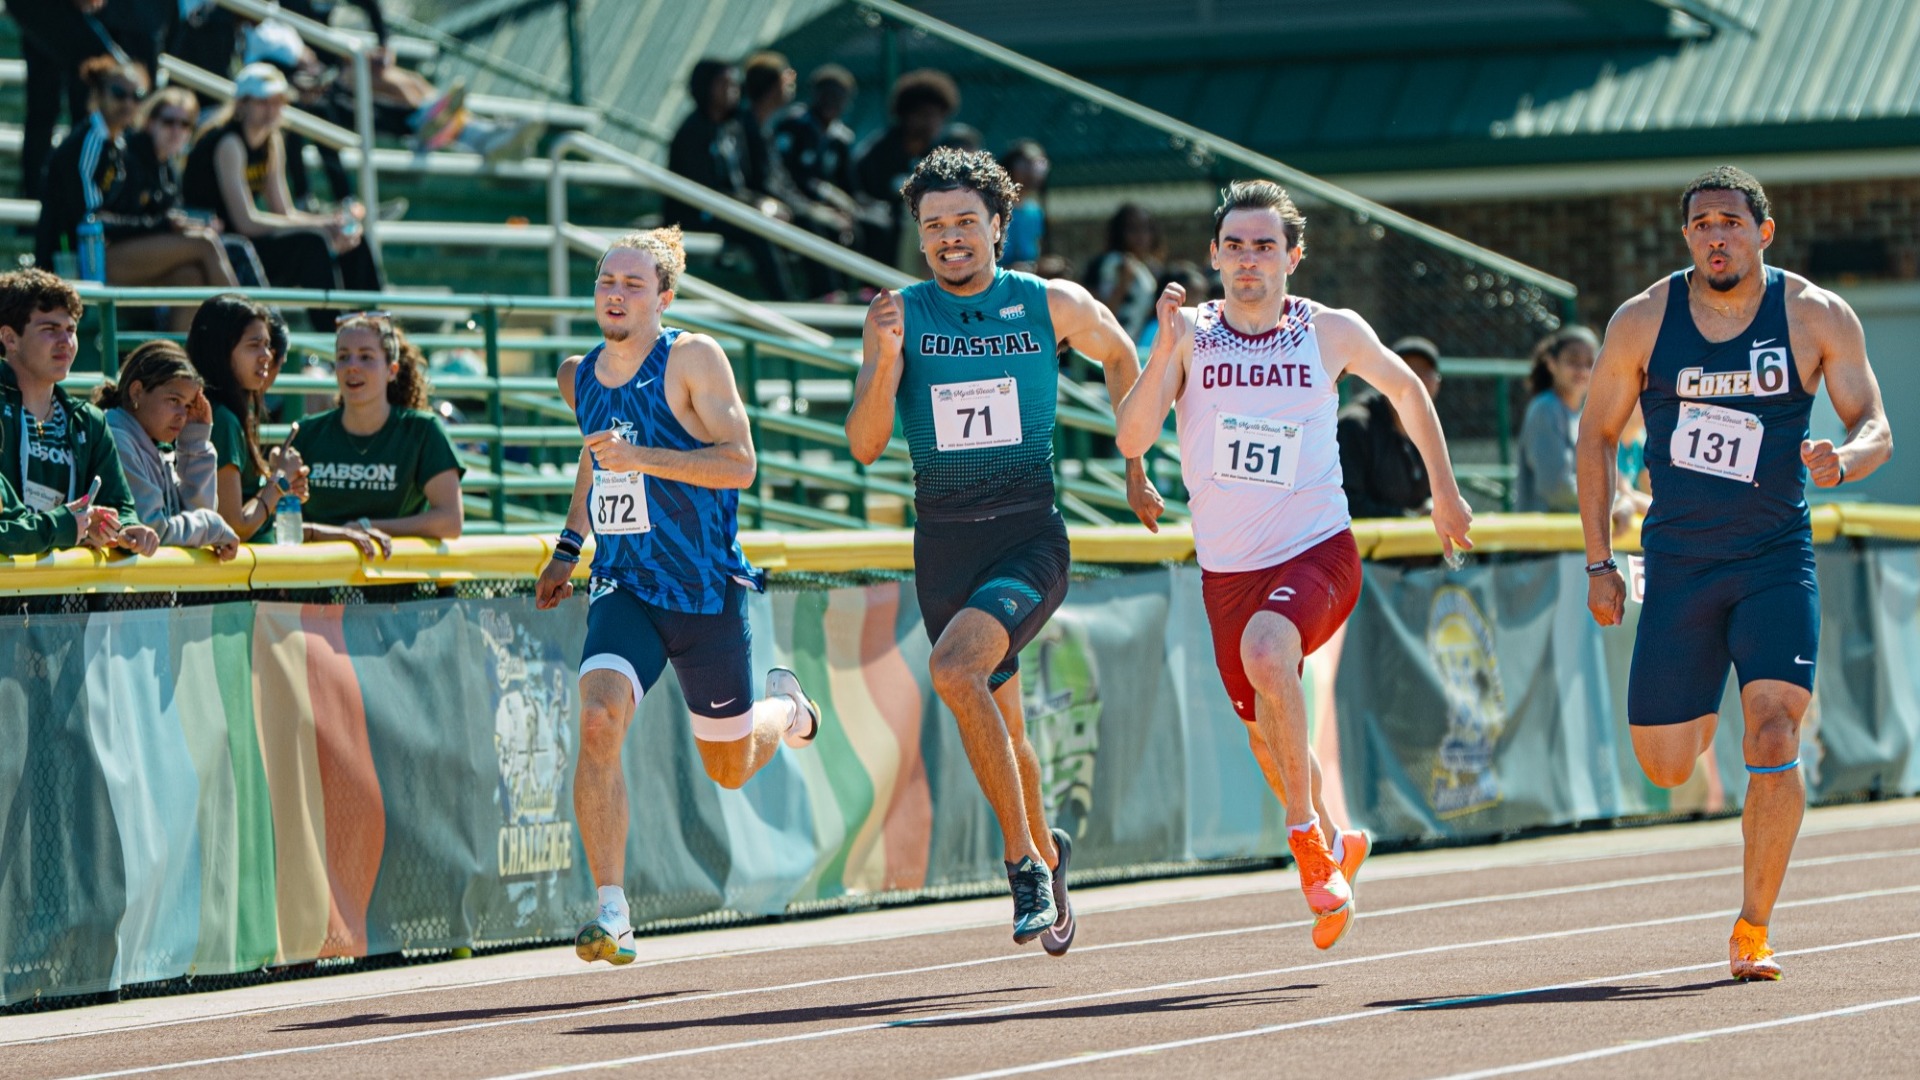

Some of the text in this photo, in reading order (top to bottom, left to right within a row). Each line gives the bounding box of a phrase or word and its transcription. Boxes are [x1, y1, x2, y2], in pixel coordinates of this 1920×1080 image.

[921, 332, 1041, 357] COASTAL
[1202, 363, 1312, 389] COLGATE
[1676, 367, 1753, 398] COKE
[1756, 351, 1784, 392] 6
[957, 405, 992, 438] 71
[1228, 440, 1282, 476] 151
[1687, 427, 1742, 467] 131
[310, 462, 397, 481] BABSON
[360, 480, 398, 491] FIELD
[597, 494, 637, 524] 872
[498, 822, 572, 877] CHALLENGE
